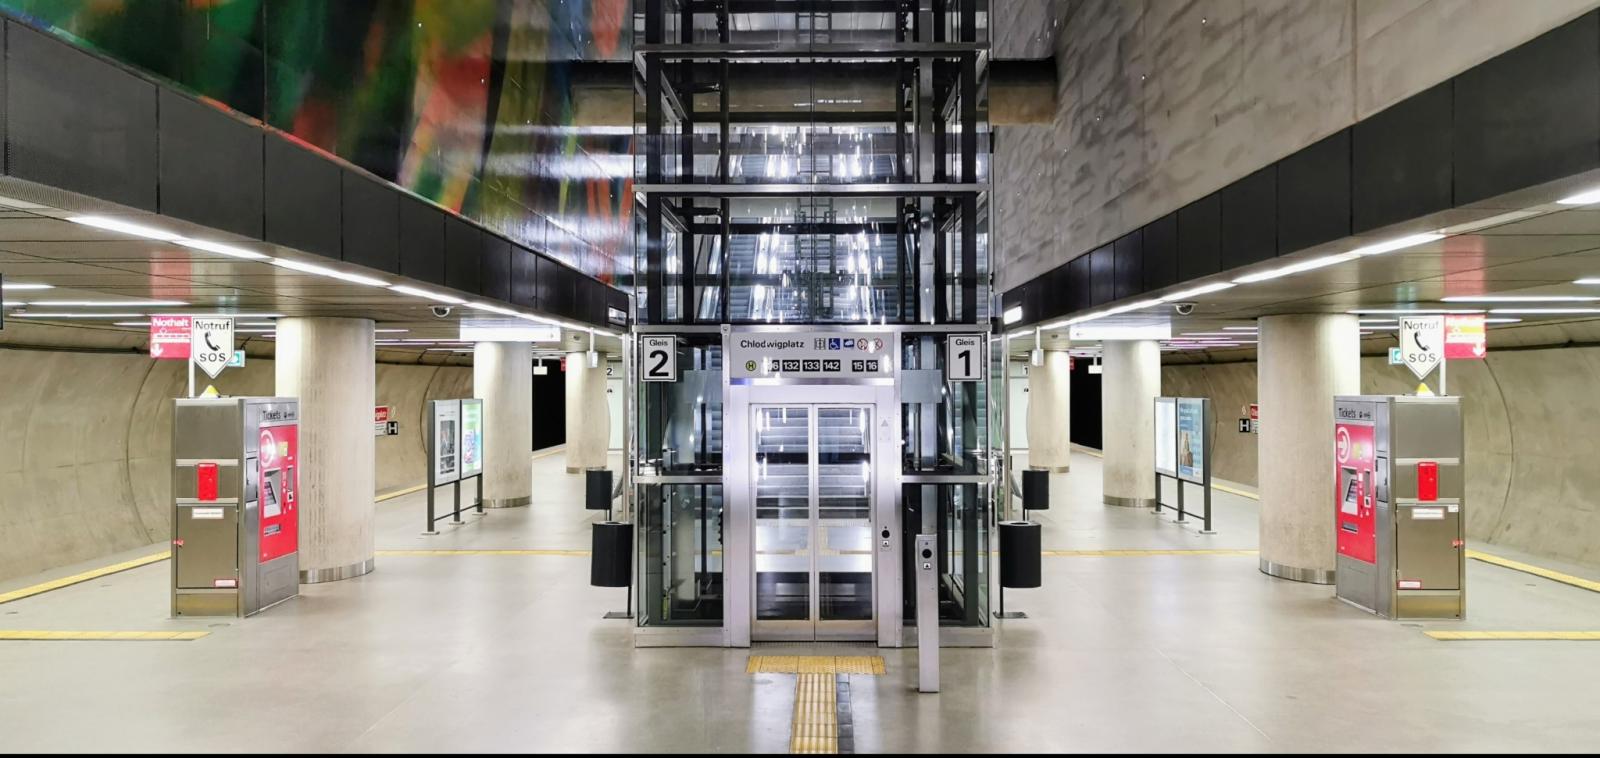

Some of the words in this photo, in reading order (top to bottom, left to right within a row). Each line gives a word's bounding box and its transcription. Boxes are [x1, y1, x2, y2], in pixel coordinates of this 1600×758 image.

[152, 318, 189, 327] Nothalt
[195, 321, 230, 330] Notruf
[1404, 321, 1439, 330] Notruf
[740, 339, 805, 349] Chlodwigplatz
[199, 353, 226, 362] SOS
[1408, 353, 1436, 362] SOS
[649, 350, 669, 377] 2
[783, 361, 799, 370] 132
[803, 361, 819, 370] 133
[823, 361, 840, 370] 142
[853, 361, 863, 370] 15
[867, 361, 877, 370] 16
[958, 350, 970, 376] 1
[262, 410, 281, 420] Tickets
[1338, 407, 1356, 418] Tickets
